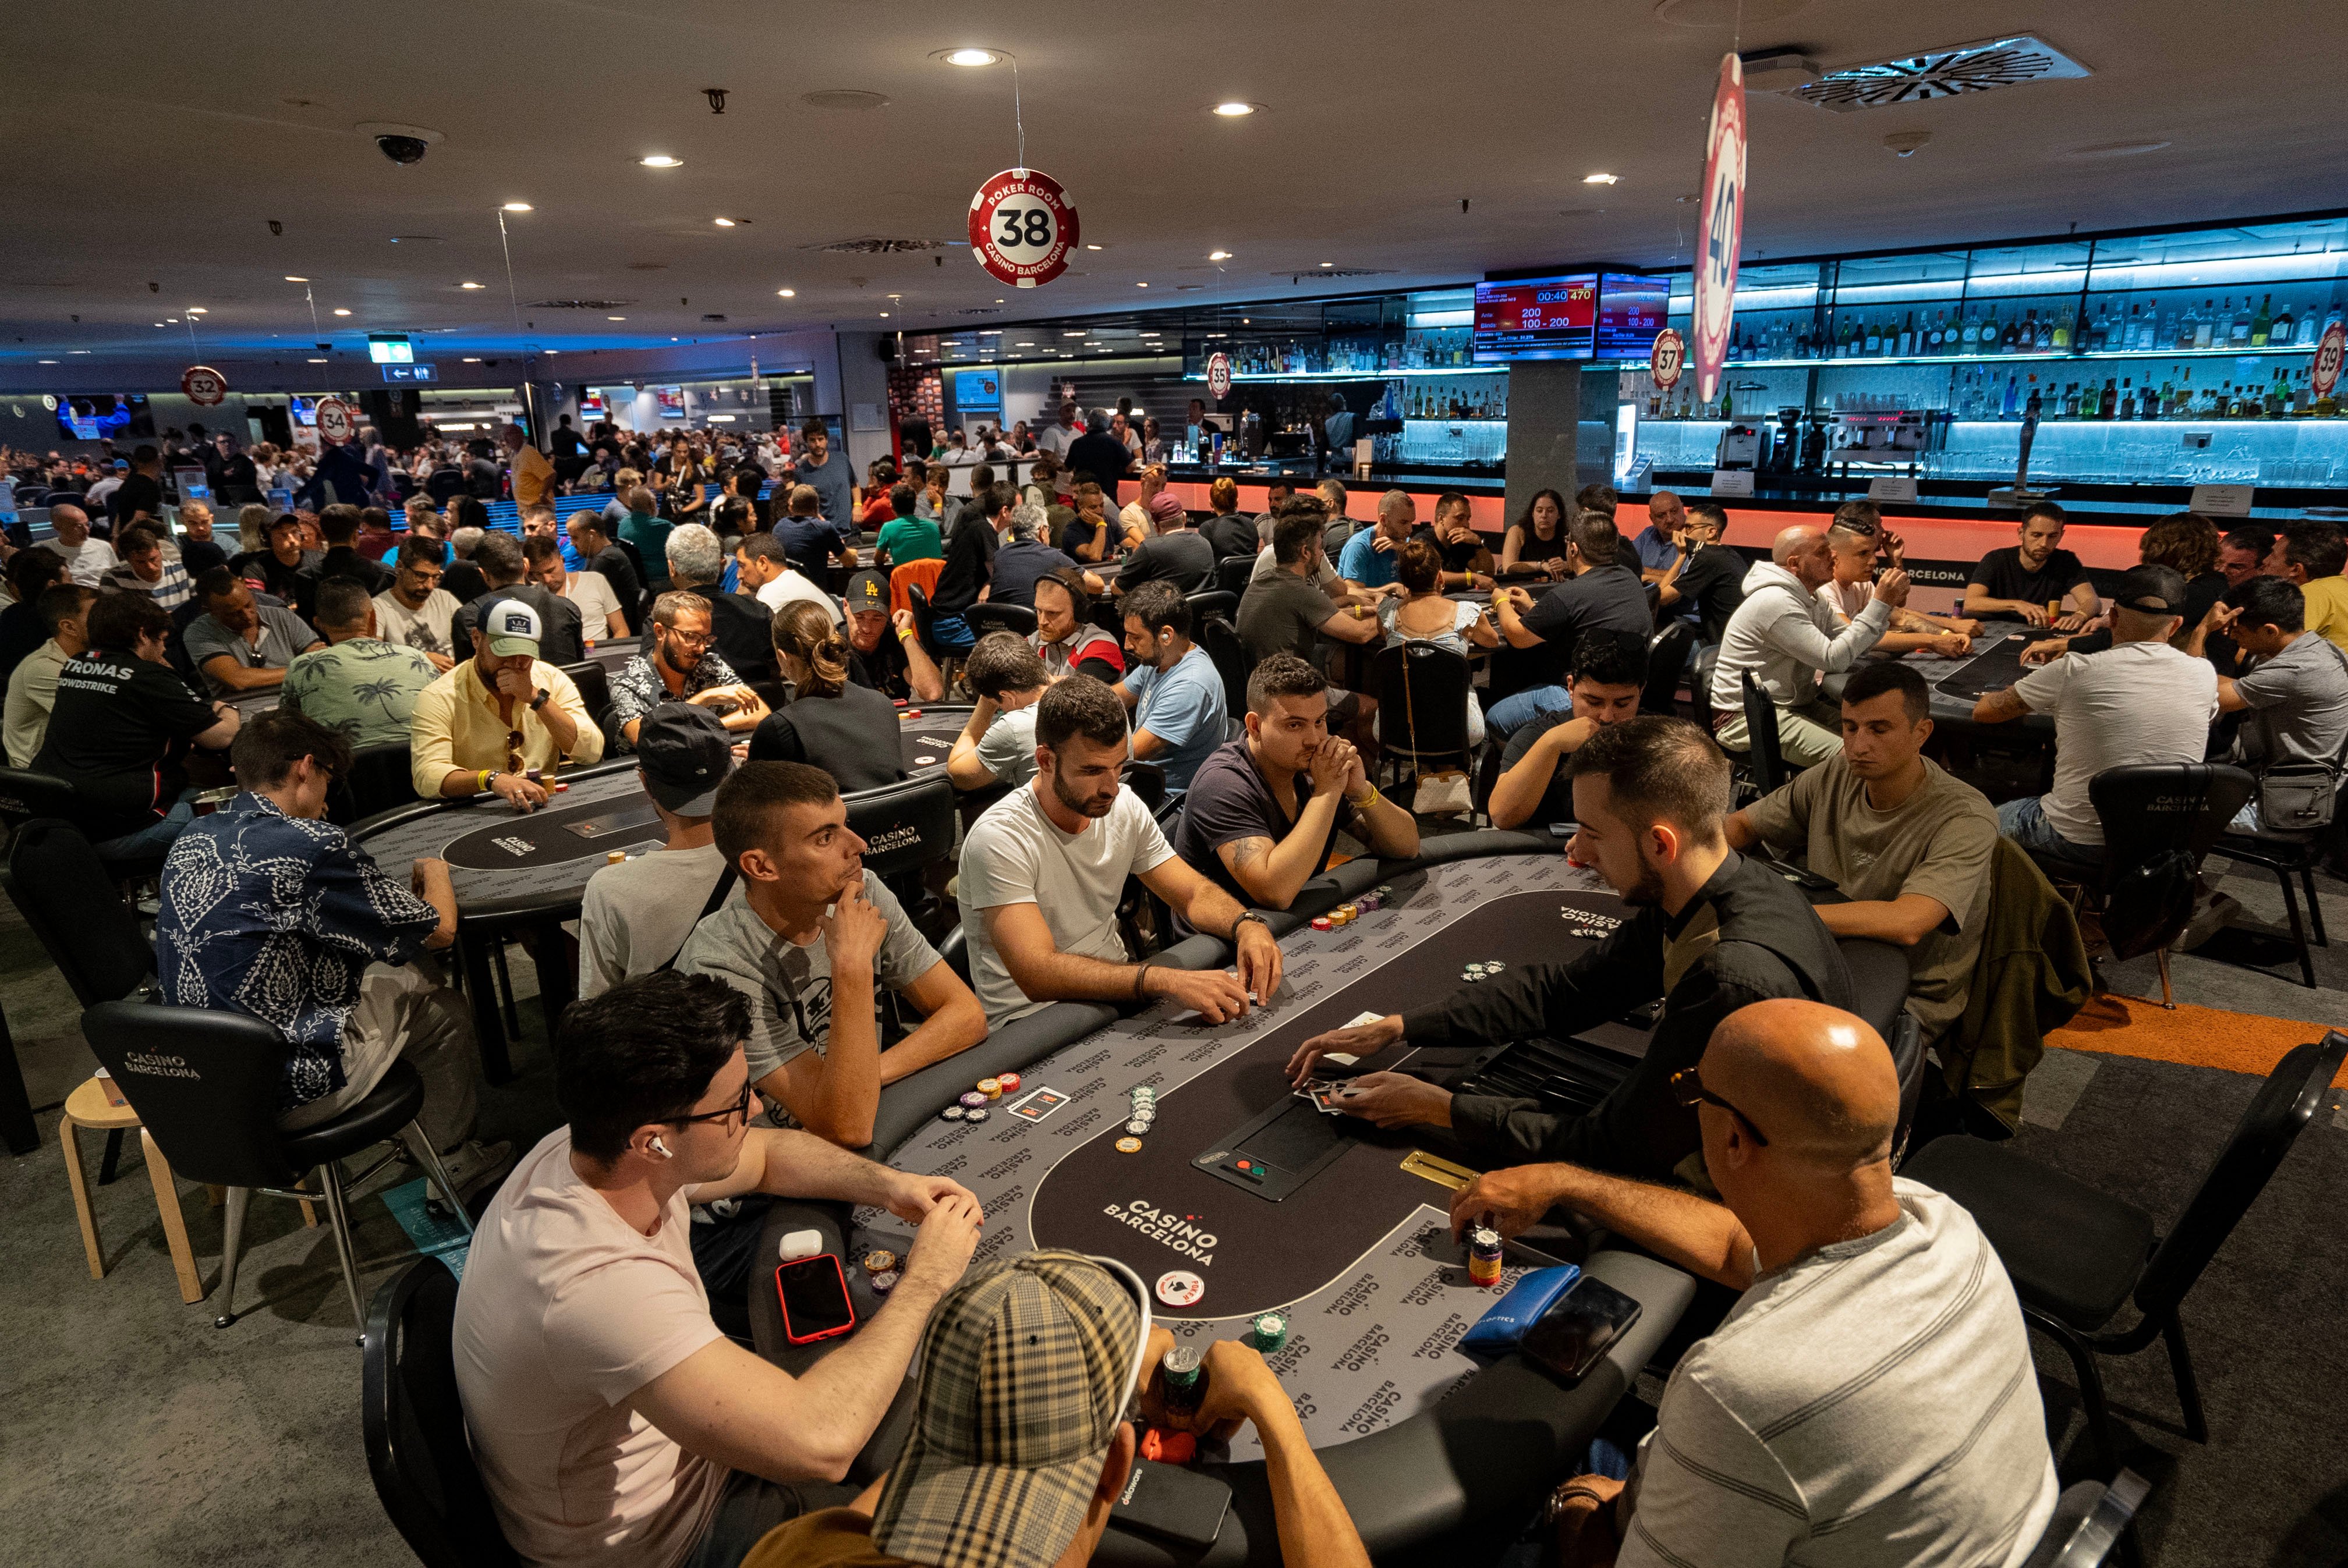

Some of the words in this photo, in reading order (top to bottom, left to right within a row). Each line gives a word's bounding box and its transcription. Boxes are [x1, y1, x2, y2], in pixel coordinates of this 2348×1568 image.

[987, 183, 1025, 206] POKER
[1029, 184, 1060, 210] ROOM
[997, 209, 1051, 247] 38
[986, 243, 1015, 273] CASINO
[1017, 241, 1065, 275] BARCELONA
[1538, 291, 1567, 301] 00:40
[1570, 290, 1591, 300] 470
[1522, 307, 1541, 318] 200
[1522, 319, 1540, 328] 100
[1549, 317, 1570, 328] 200
[1628, 307, 1639, 315] 200
[1628, 318, 1638, 326] 100
[1643, 318, 1654, 327] 200
[1659, 336, 1671, 348] POKER
[1660, 350, 1677, 370] 37
[2320, 347, 2338, 372] 39
[193, 381, 217, 393] 32
[1214, 368, 1225, 383] 35
[325, 413, 345, 429] 34
[1908, 569, 1965, 581] RCELONA
[866, 580, 878, 596] LA
[64, 658, 134, 680] TRONAS
[59, 677, 118, 693] ROWDSTRIKE
[505, 837, 536, 852] CASINO
[865, 834, 921, 856] BARCELONA
[870, 826, 915, 845] CASINO
[1561, 913, 1620, 930] ASINO
[128, 1051, 185, 1067] CASINO
[1076, 1054, 1111, 1074] CASINO
[1133, 1048, 1168, 1068] CASINO
[1190, 1043, 1223, 1062] CASINO
[125, 1061, 201, 1081] BARCELONA
[1069, 1077, 1104, 1099] BARCELO
[1071, 1082, 1106, 1104] CASINO
[1051, 1108, 1099, 1136] BARCELONA
[1063, 1113, 1102, 1136] CASINO
[937, 1126, 979, 1150] CASINO
[978, 1147, 1031, 1179] BARCELONA
[990, 1154, 1032, 1180] CASINO
[983, 1192, 1024, 1220] CASINO
[1103, 1204, 1213, 1267] BARCELONA
[1129, 1200, 1217, 1248] CASINO
[969, 1233, 1014, 1265] CASINO
[1390, 1219, 1435, 1257] BARCELONA
[1404, 1227, 1442, 1258] CASINO
[1323, 1273, 1375, 1315] BARCELONA
[1400, 1264, 1448, 1305] BARCELONA
[1415, 1273, 1454, 1306] CASINO
[1339, 1282, 1380, 1316] CASINO
[1411, 1312, 1462, 1358] BARCELONA
[1428, 1322, 1469, 1360] CASINO
[1330, 1323, 1384, 1371] BARCELONA
[1347, 1333, 1390, 1372] CASINO
[1274, 1345, 1310, 1377] CASIN
[1340, 1379, 1396, 1433] BARCELONA
[1356, 1391, 1402, 1434] CASINO
[1121, 1468, 1143, 1505] delaware
